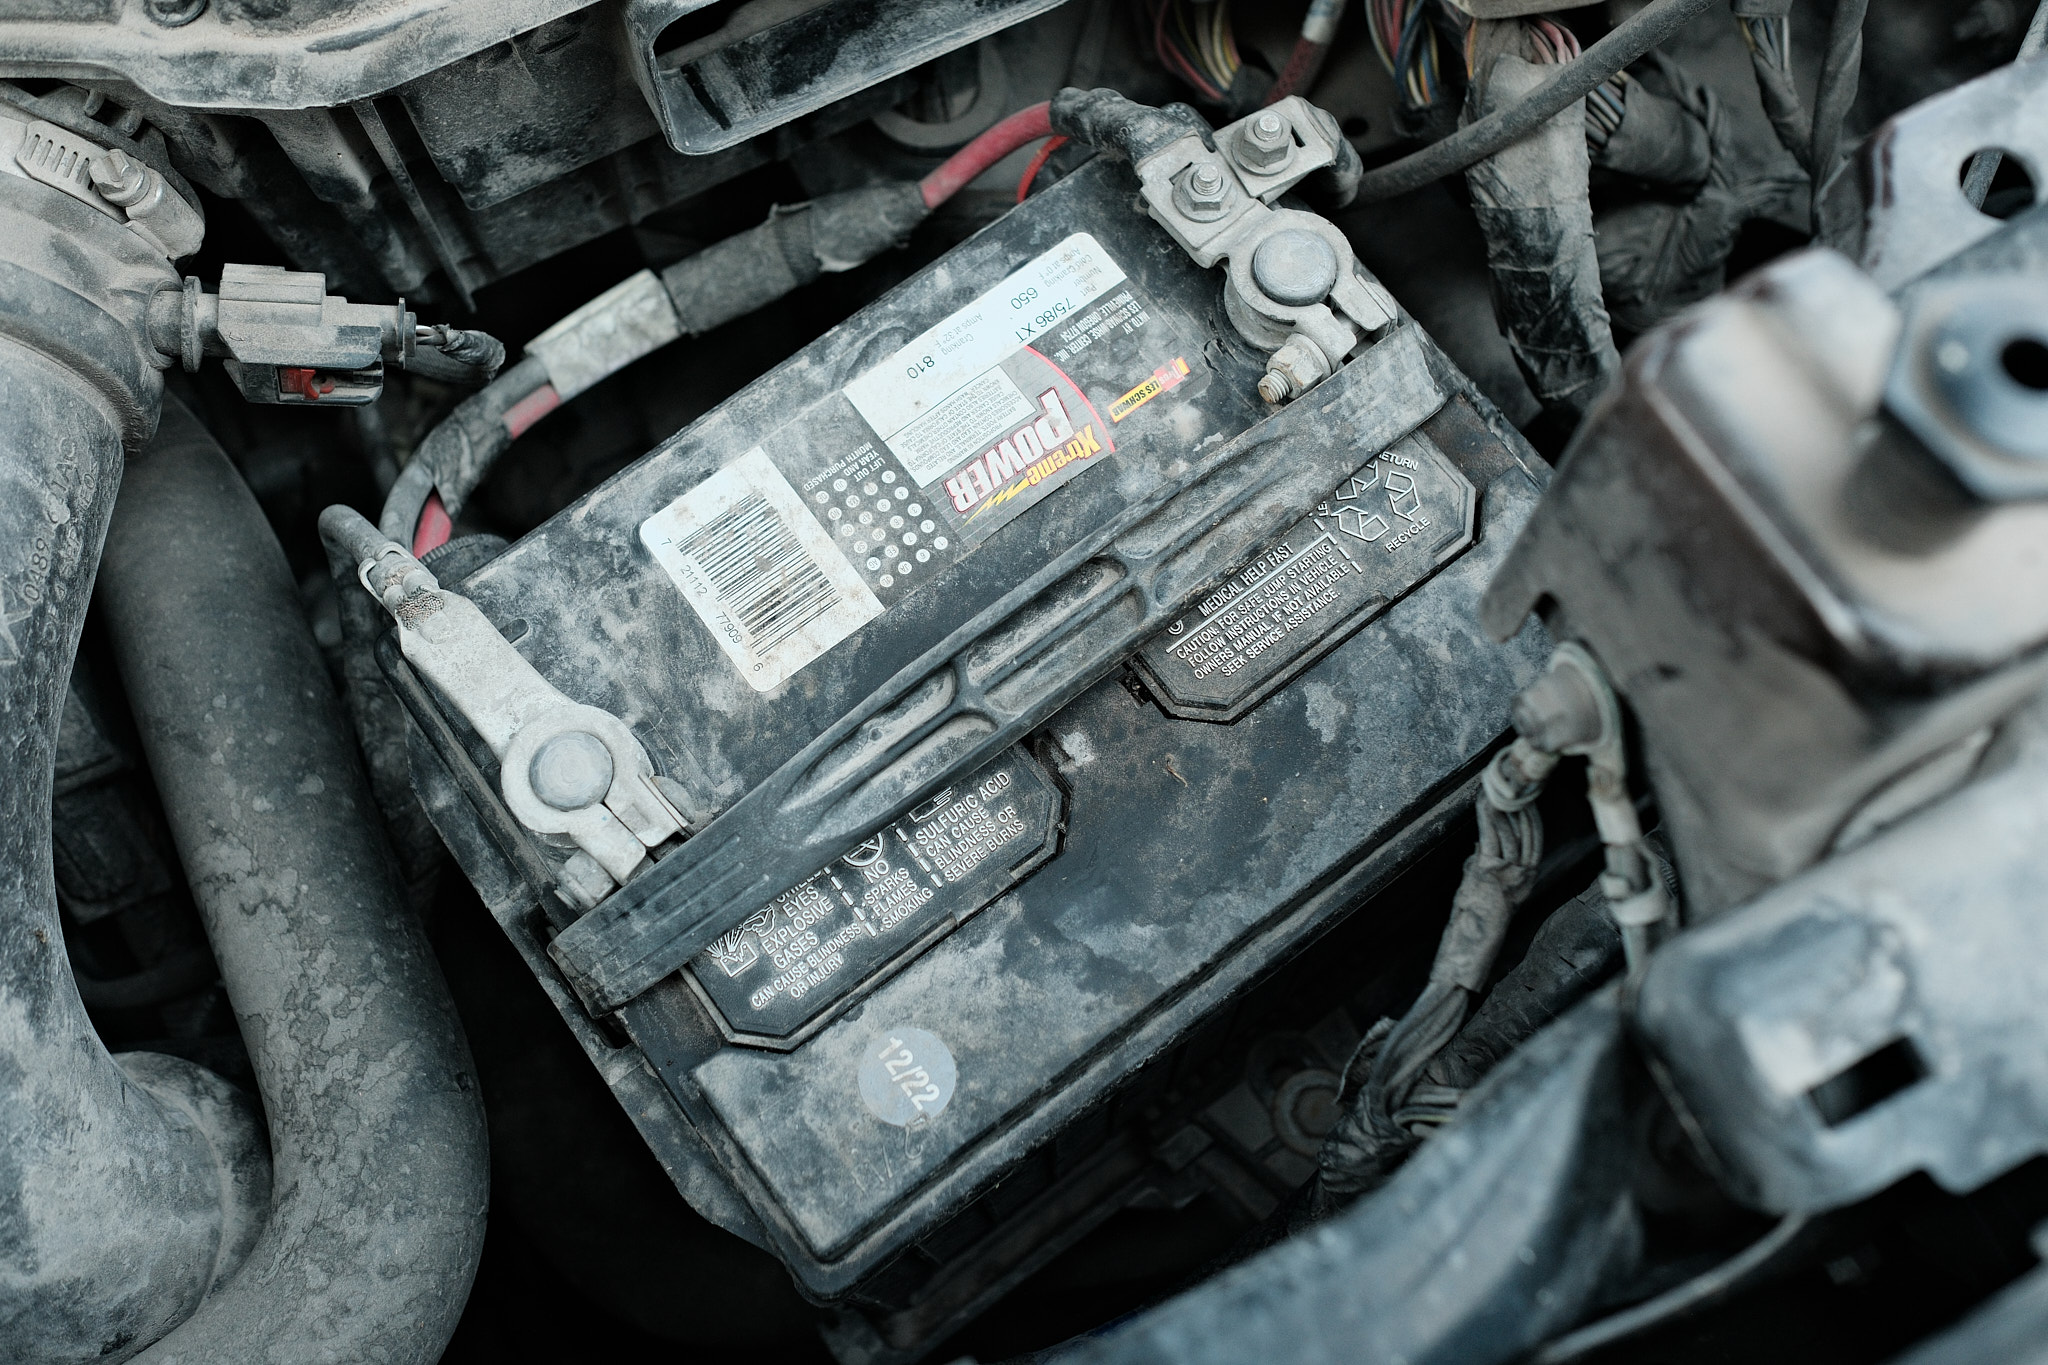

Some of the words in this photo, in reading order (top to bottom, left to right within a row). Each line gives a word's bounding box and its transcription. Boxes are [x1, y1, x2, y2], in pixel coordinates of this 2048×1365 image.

[1044, 263, 1078, 290] Cranking
[1072, 265, 1101, 288] Number
[1010, 287, 1038, 310] 650
[1080, 283, 1097, 297] Part
[1035, 297, 1075, 328] 75/86
[1104, 306, 1131, 329] SCHWAB
[1126, 299, 1142, 314] LES
[953, 326, 962, 335] at
[960, 312, 983, 330] Amps
[1015, 322, 1036, 343] XT
[1075, 310, 1102, 332] OREGON
[1121, 322, 1134, 334] BY
[940, 331, 974, 358] Cranking
[1064, 332, 1092, 356] CENTER,
[906, 355, 935, 379] 810
[1053, 348, 1070, 364] INC.
[1144, 380, 1160, 394] LES
[954, 399, 968, 411] STATE
[965, 400, 978, 410] ALSO
[970, 400, 989, 415] CANCER
[992, 390, 1017, 408] CHEMICALS
[1111, 389, 1147, 416] SCHWAB
[921, 413, 948, 433] CALIFORNIA
[946, 408, 967, 424] CONTAIN
[960, 413, 971, 422] AND
[972, 414, 992, 429] CONTAIN
[975, 406, 993, 419] KNOWN
[996, 406, 1016, 421] BATTERY
[947, 429, 961, 440] STATE
[959, 422, 970, 430] THE
[960, 427, 974, 438] LEAD
[939, 442, 952, 453] LEAD
[942, 386, 1073, 513] POWER
[950, 435, 962, 445] AND
[845, 441, 873, 463] MONTH
[858, 449, 879, 466] YEAR
[925, 454, 946, 470] RELATED
[945, 448, 956, 457] AND
[1025, 424, 1102, 487] Xtreme
[1379, 451, 1419, 471] ETURN
[802, 459, 846, 491] PURCHASED
[842, 461, 860, 476] AND
[852, 467, 870, 482] OUT
[868, 457, 886, 471] LIFT
[1384, 515, 1430, 552] RECYCLE
[1197, 581, 1244, 616] MEDICAL
[1239, 560, 1267, 586] HELP
[1266, 541, 1294, 567] FAST
[660, 537, 671, 547] 7
[678, 564, 709, 597] 21112
[713, 611, 744, 645] 77909
[751, 661, 764, 673] 6
[1176, 626, 1219, 658] CAUTION:
[1216, 610, 1240, 629] FOR
[1237, 592, 1264, 614] SAFE
[1261, 574, 1286, 597] JUMP
[1286, 542, 1332, 578] STARTING
[1187, 635, 1226, 667] FOLLOW
[1224, 589, 1290, 640] INSTRUCTIONS
[1287, 580, 1302, 594] IN
[1298, 554, 1338, 585] VEHICLE
[1194, 647, 1235, 679] OWNERS
[1232, 621, 1274, 651] MANUAL.
[1271, 610, 1285, 623] IF
[1281, 595, 1304, 615] NOT
[1303, 562, 1350, 601] AVAILABLE
[1221, 654, 1247, 676] SEEK
[1245, 626, 1285, 658] SERVICE
[1283, 585, 1341, 632] ASSISTANCE.
[915, 794, 981, 845] SULFURIC
[978, 772, 1011, 801] ACID
[925, 834, 952, 857] CAN
[951, 806, 989, 838] CAUSE
[933, 820, 998, 870] BLINDNESS
[997, 805, 1016, 823] OR
[942, 845, 988, 881] SEVERE
[984, 818, 1024, 851] BURNS
[863, 859, 889, 883] NO
[864, 867, 909, 904] SPARKS
[782, 885, 821, 918] EYES
[872, 879, 919, 917] FLAMES
[881, 887, 934, 928] SMOKING
[761, 895, 834, 954] EXPLOSIVE
[773, 930, 818, 968] GASES
[751, 985, 775, 1007] CAN
[773, 961, 809, 991] CAUSE
[806, 922, 863, 968] BLINDNESS
[790, 980, 808, 998] OR
[806, 953, 844, 986] INJURY
[878, 1036, 940, 1111] 12/22
